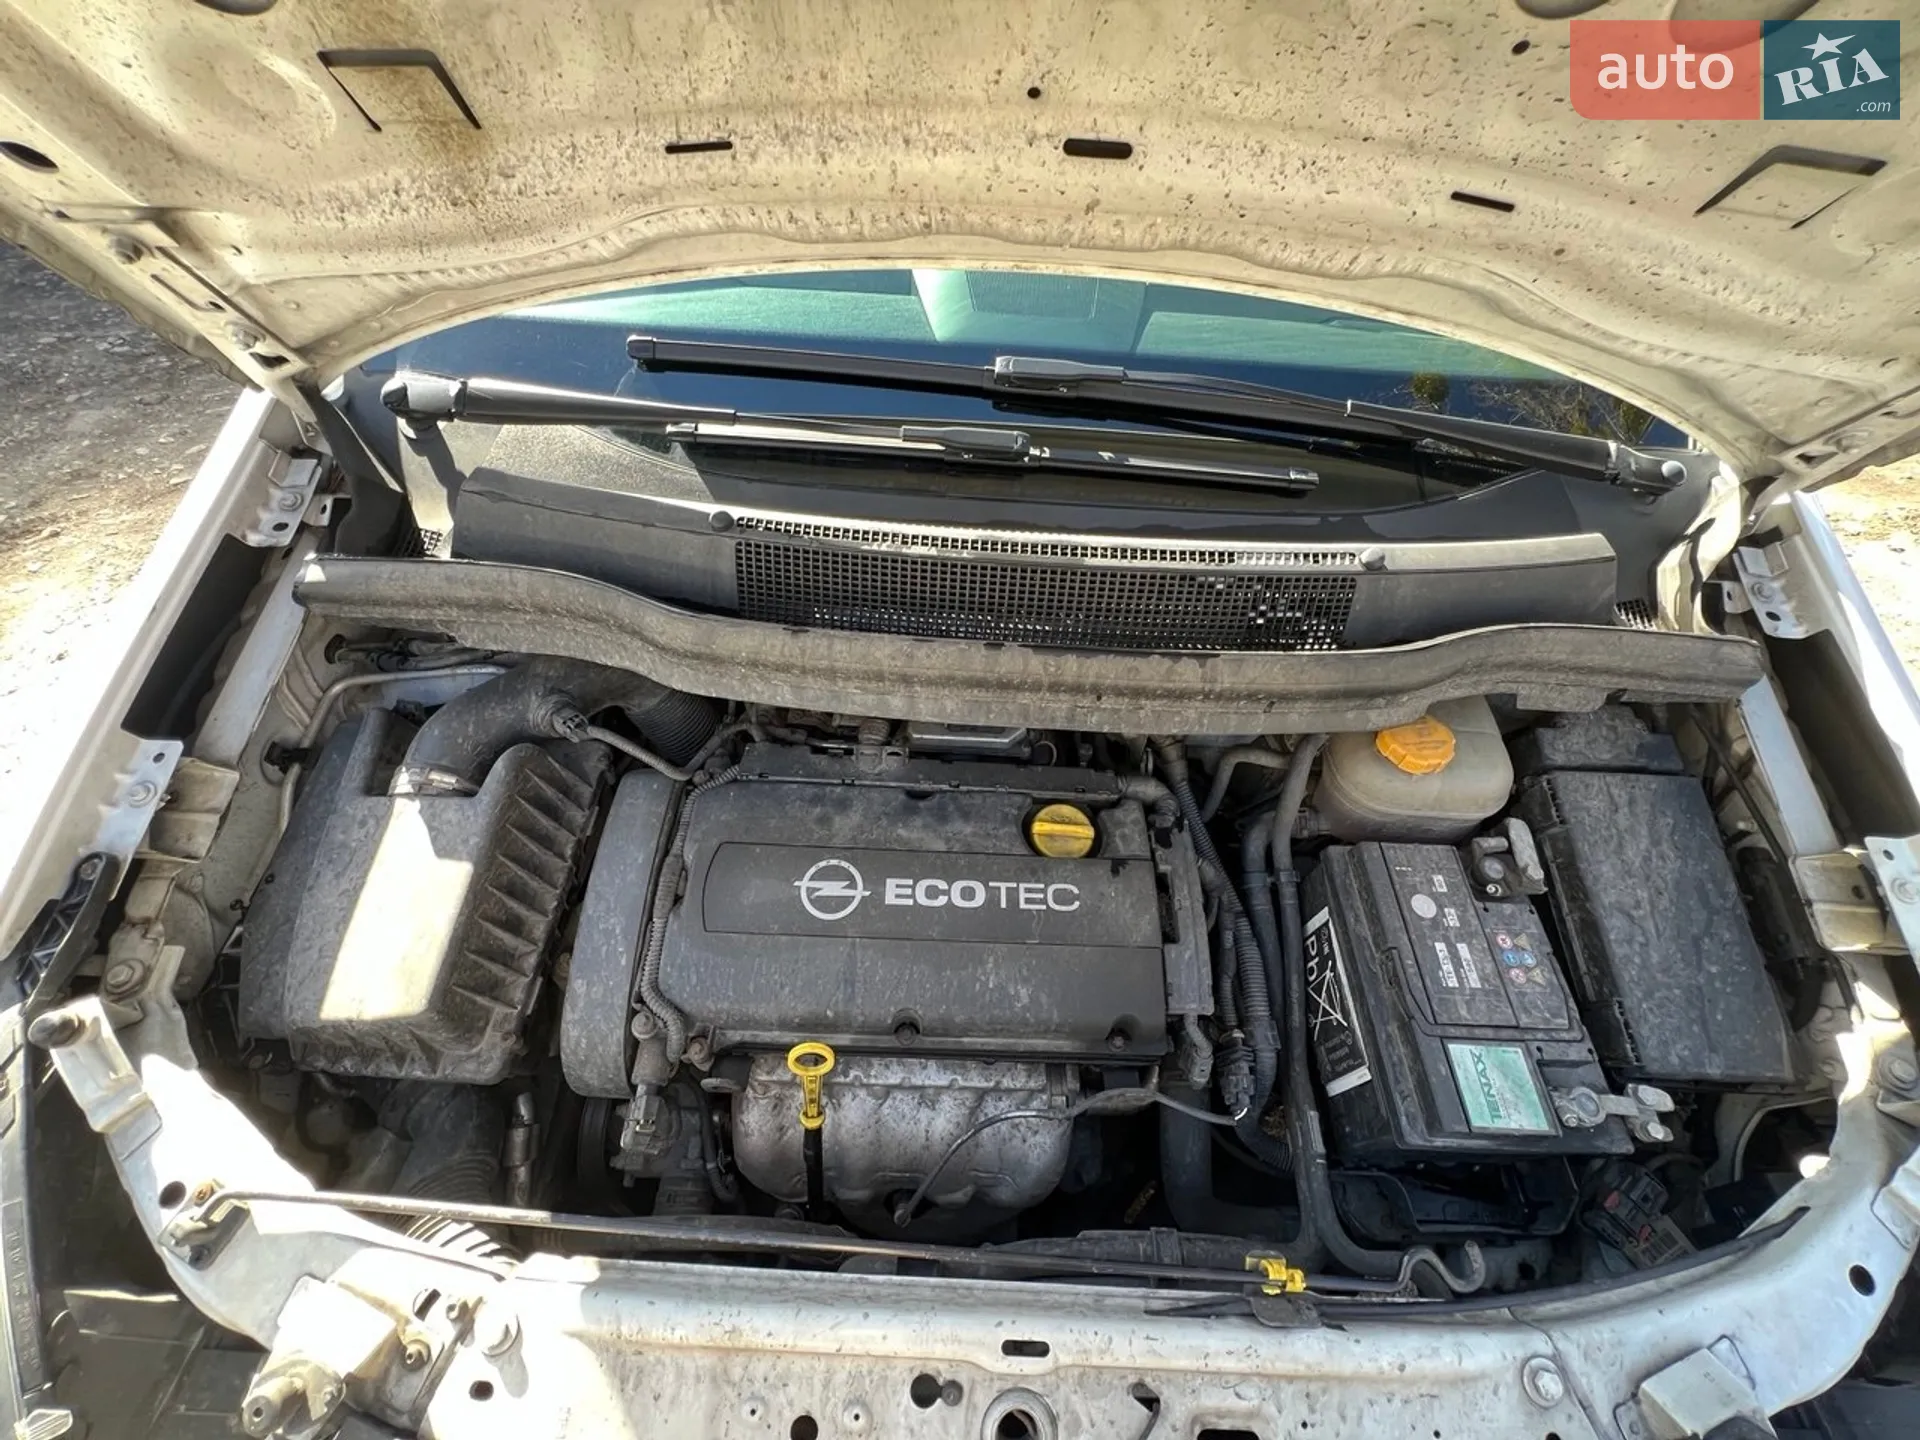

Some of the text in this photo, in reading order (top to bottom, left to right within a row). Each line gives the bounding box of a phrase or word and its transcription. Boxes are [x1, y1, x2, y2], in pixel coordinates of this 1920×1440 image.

[884, 877, 1081, 911] ECOTEC
[1304, 934, 1320, 981] Pb
[1468, 1048, 1503, 1124] TENAX
